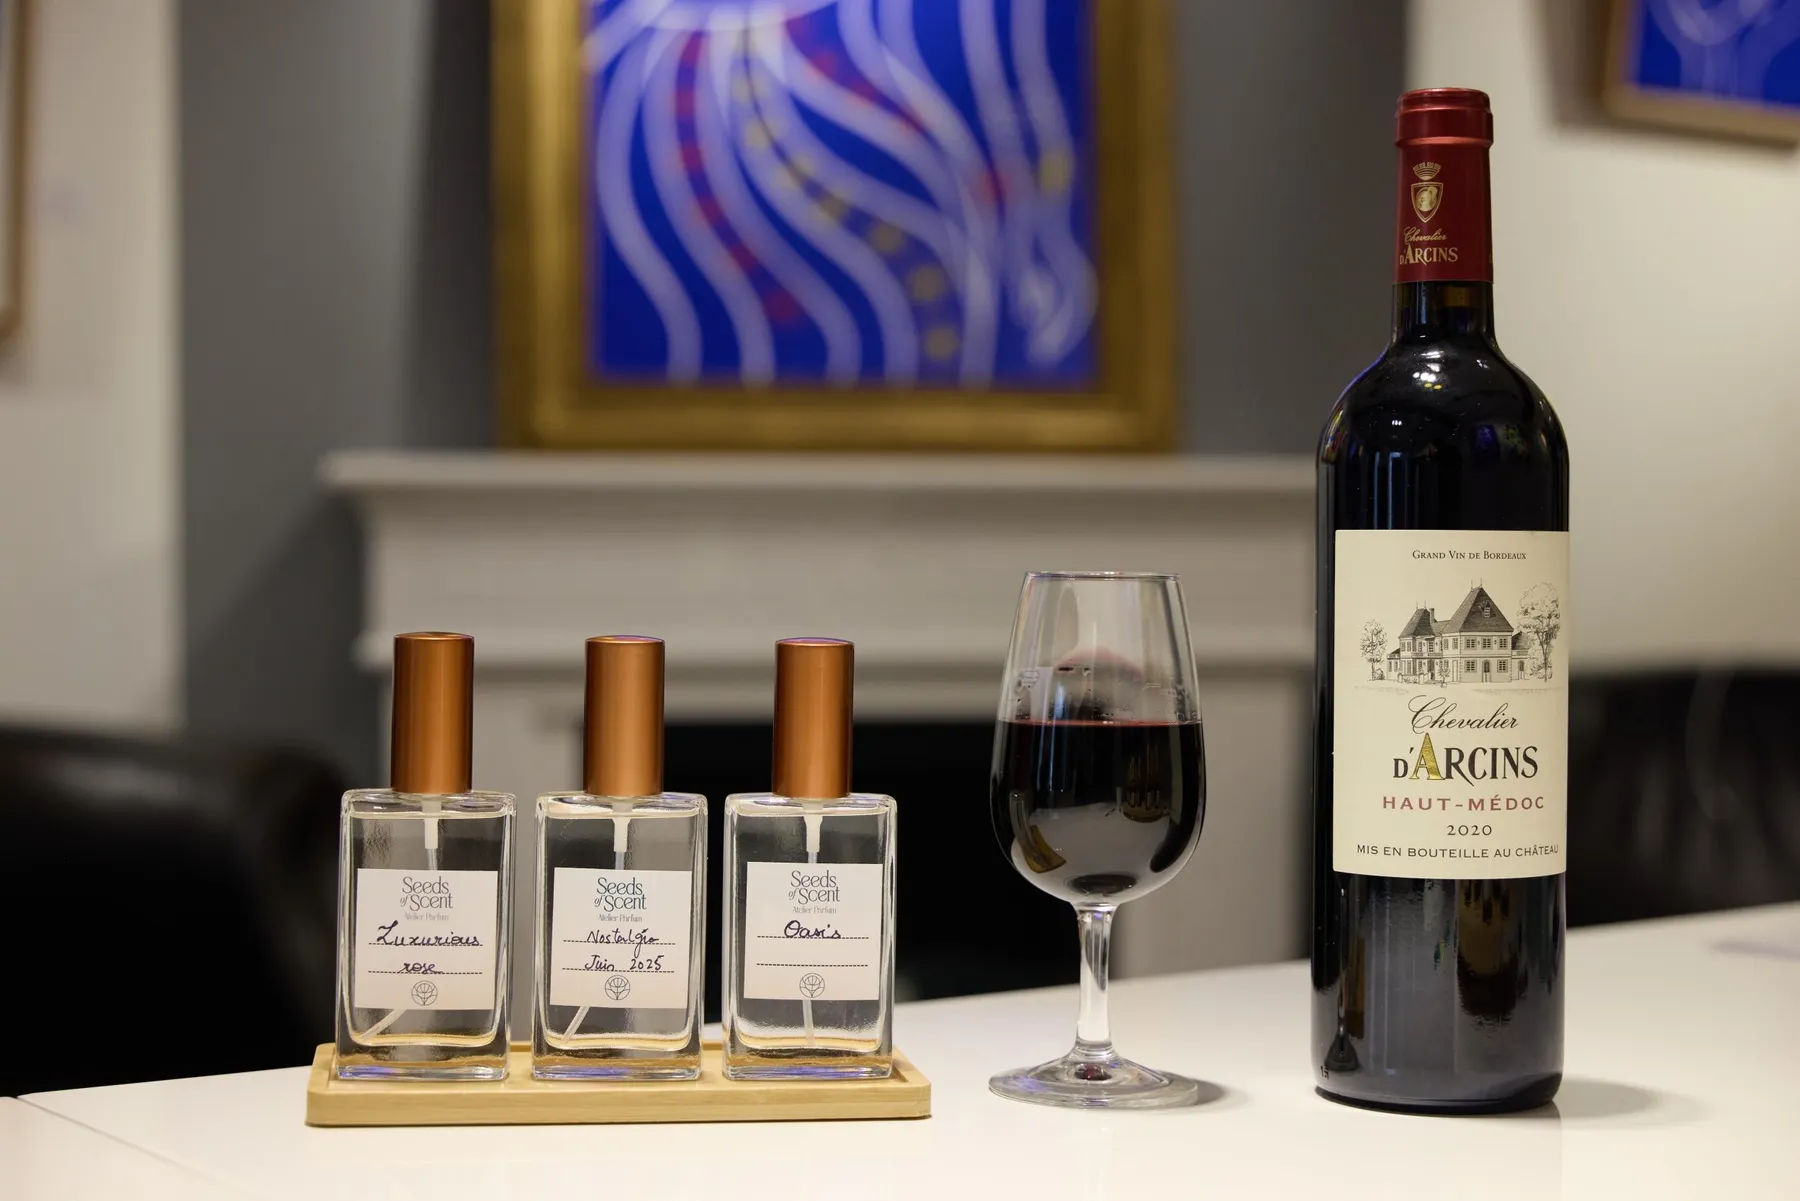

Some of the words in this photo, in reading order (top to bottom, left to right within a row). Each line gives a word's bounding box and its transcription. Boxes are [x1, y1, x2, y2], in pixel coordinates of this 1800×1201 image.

[1403, 226, 1447, 244] Chevalier
[1399, 243, 1458, 266] D'ARCINS
[1412, 549, 1446, 560] GRAND
[1448, 550, 1466, 560] VIN
[1483, 550, 1527, 560] BORDEAUX
[1407, 694, 1519, 734] Chevalier
[1393, 732, 1538, 787] D'ARCINS
[1382, 795, 1545, 811] HAUT-MÉDOC
[1446, 824, 1493, 836] 2020
[1357, 844, 1379, 855] MIS
[1383, 846, 1402, 857] EN
[1407, 847, 1489, 858] BOUTEILLE
[1493, 847, 1511, 858] AU
[1515, 844, 1559, 857] CHÂTEAU
[402, 875, 450, 894] Seeds
[596, 877, 643, 895] Seeds
[790, 869, 837, 888] Seeds
[400, 894, 409, 908] of
[409, 893, 453, 911] Scent
[594, 895, 604, 908] of
[603, 894, 647, 912] Scent
[788, 888, 798, 901] of
[797, 887, 840, 905] Scent
[376, 919, 480, 947] Luxurious
[784, 919, 842, 939] Oasis
[400, 962, 443, 975] rose
[584, 954, 615, 971] Juin
[629, 954, 665, 971] 2025
